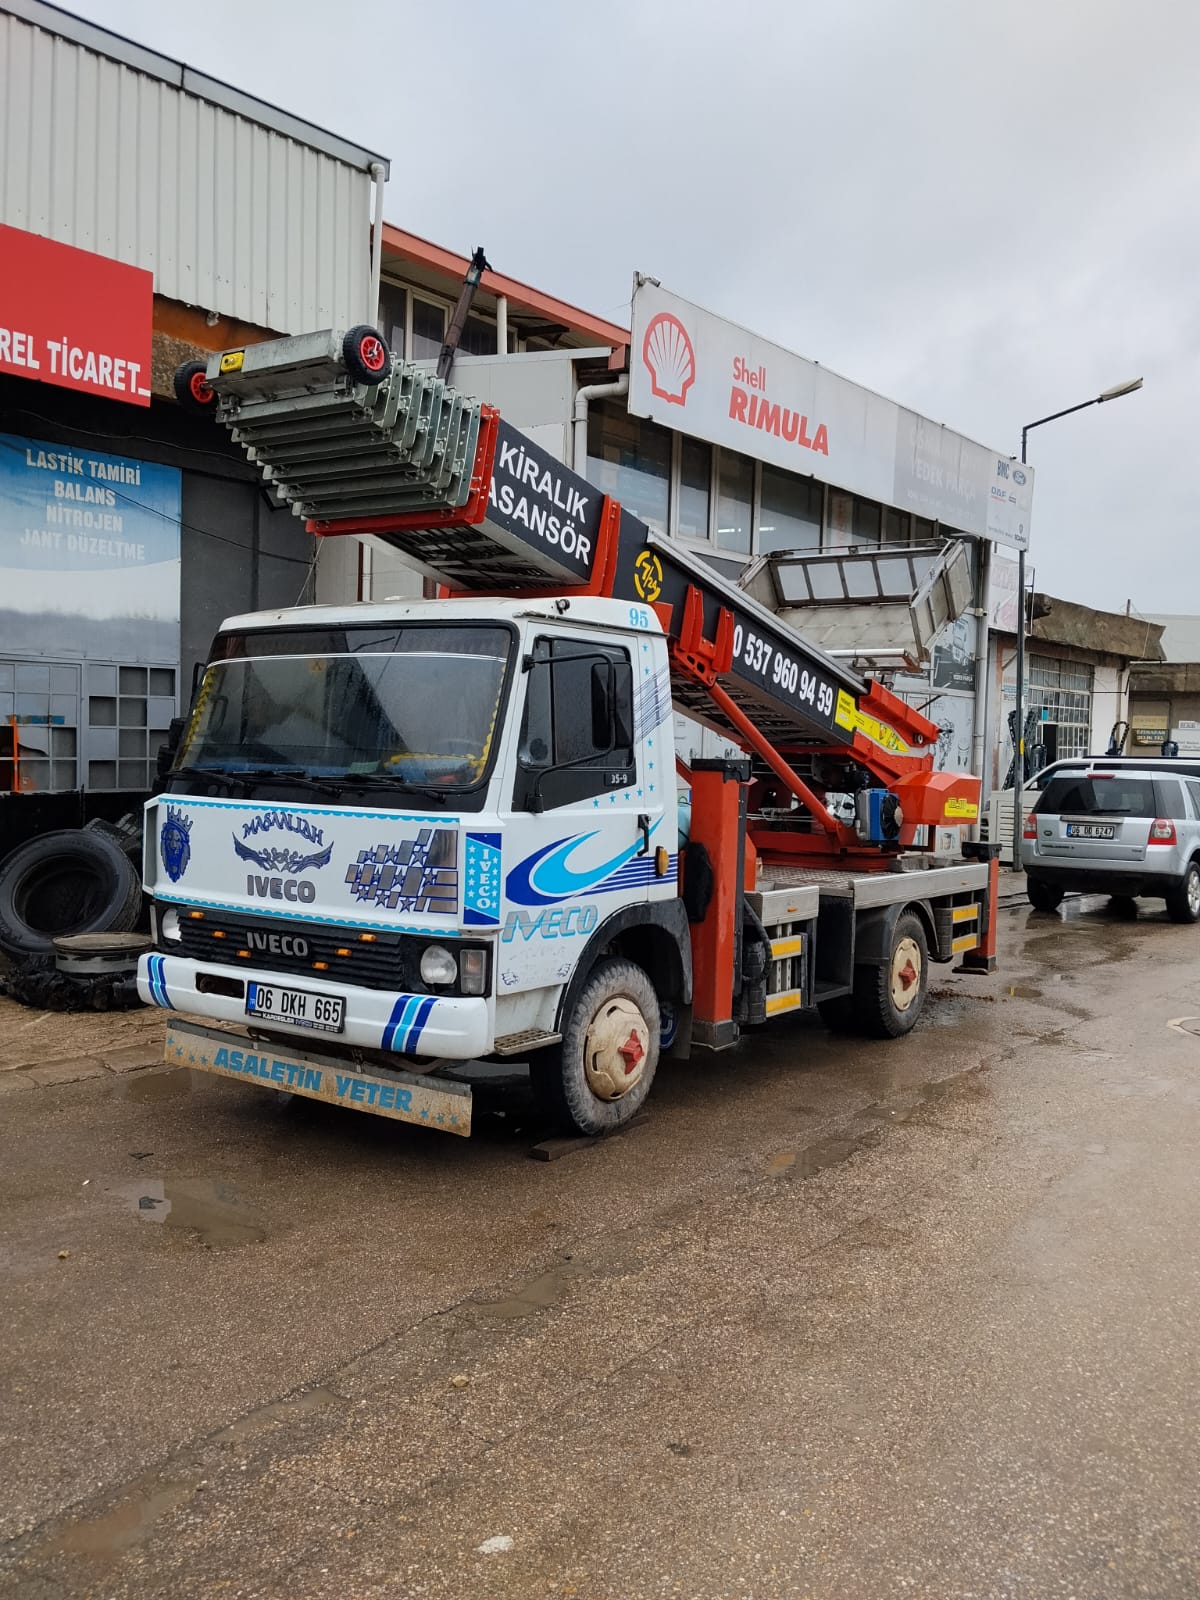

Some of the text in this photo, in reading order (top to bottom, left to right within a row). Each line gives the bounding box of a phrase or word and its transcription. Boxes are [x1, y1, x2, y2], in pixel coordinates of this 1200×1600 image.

[733, 356, 766, 392] Shell
[729, 386, 829, 456] RIMULA
[26, 448, 141, 486] LASTİK TAMİRİ
[499, 441, 589, 524] KİRALIK
[54, 480, 116, 507] BALANS
[46, 503, 123, 532] NİTROJEN
[488, 477, 591, 566] ASANSÖR
[20, 528, 145, 560] JANT DÜZELTME
[641, 561, 658, 591] 7/24
[629, 608, 648, 628] 95
[733, 625, 833, 716] 0 537 960 94 59
[611, 774, 628, 784] 35-9
[1071, 826, 1081, 834] 06
[1096, 828, 1113, 836] 6247
[246, 874, 316, 904] IVECO
[476, 848, 492, 909] IVECO
[502, 904, 599, 944] IVECO
[246, 931, 309, 958] IVECO
[256, 988, 341, 1023] 06 DKH 665
[335, 1075, 413, 1113] YETER
